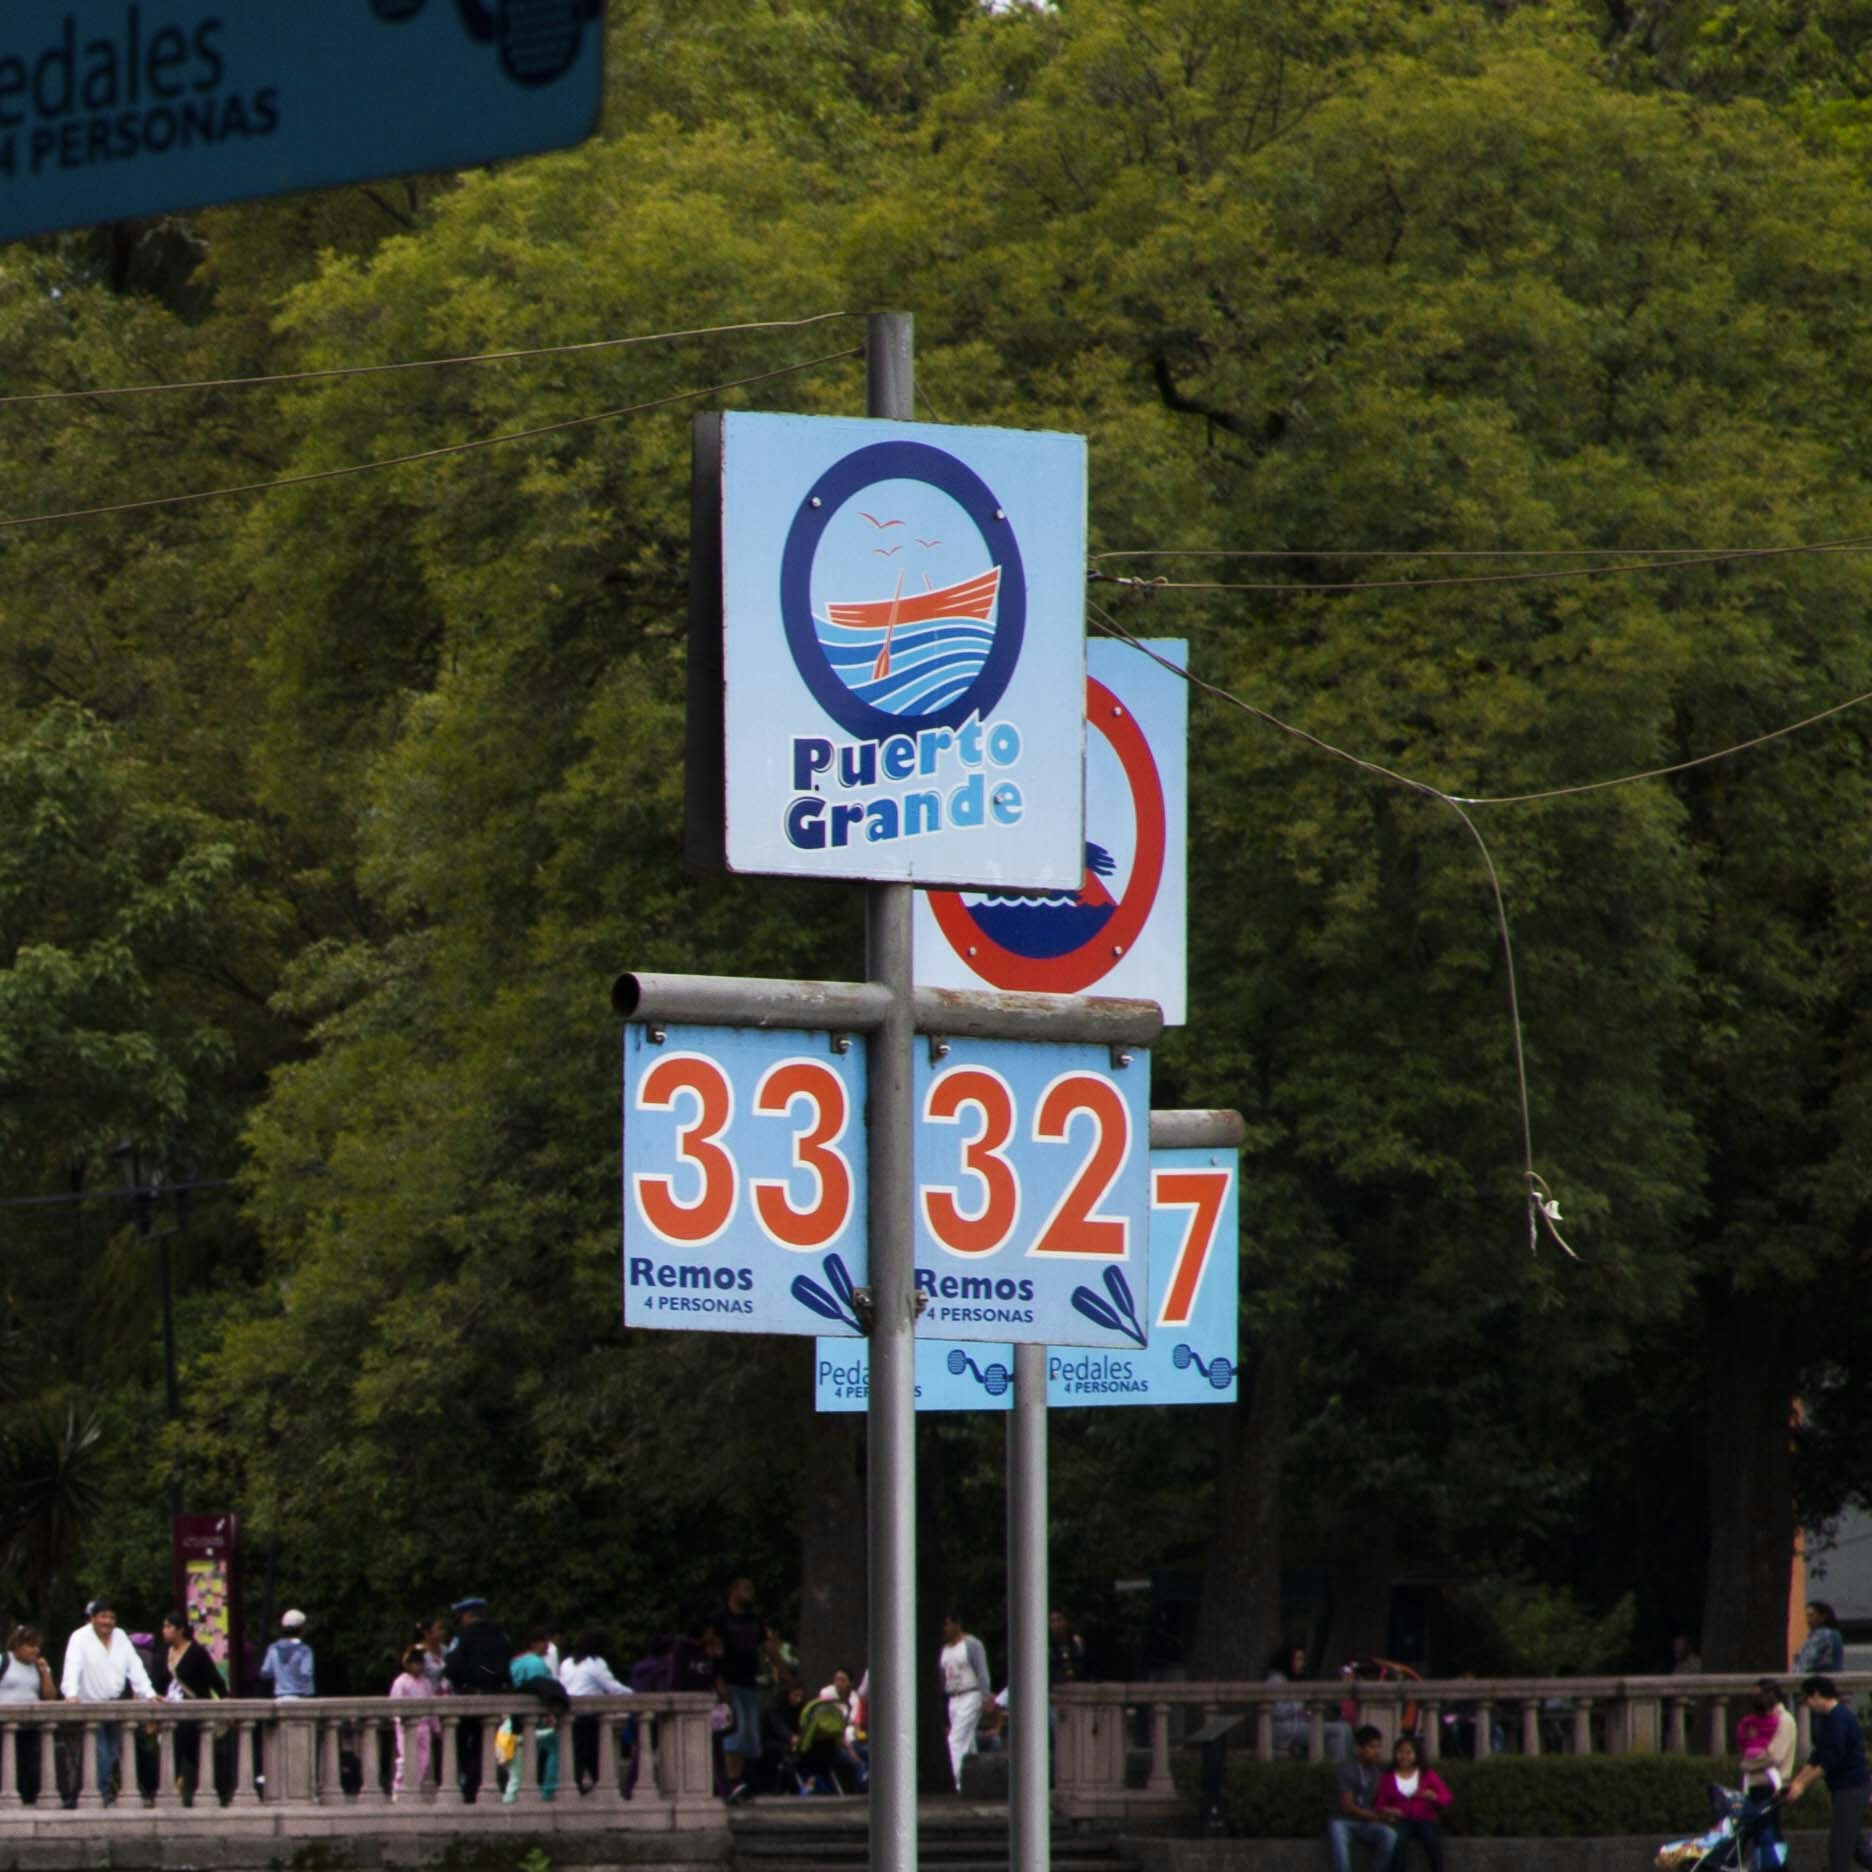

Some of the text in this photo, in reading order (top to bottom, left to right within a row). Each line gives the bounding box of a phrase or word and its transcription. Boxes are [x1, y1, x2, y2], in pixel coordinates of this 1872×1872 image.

[31, 87, 278, 174] PERSONAS
[791, 711, 1023, 792] Puerto
[783, 772, 1024, 850] Grande
[632, 1050, 855, 1252] 33
[920, 1063, 1134, 1262] 32
[630, 1256, 754, 1291] Remos
[915, 1268, 1034, 1301] Remos
[644, 1296, 754, 1314] 4 PERSONAS
[927, 1307, 1034, 1323] 4 PERSONAS
[1050, 1355, 1133, 1381] Pedales
[835, 1387, 842, 1398] 4
[1064, 1381, 1149, 1393] 4 PERSONAS
